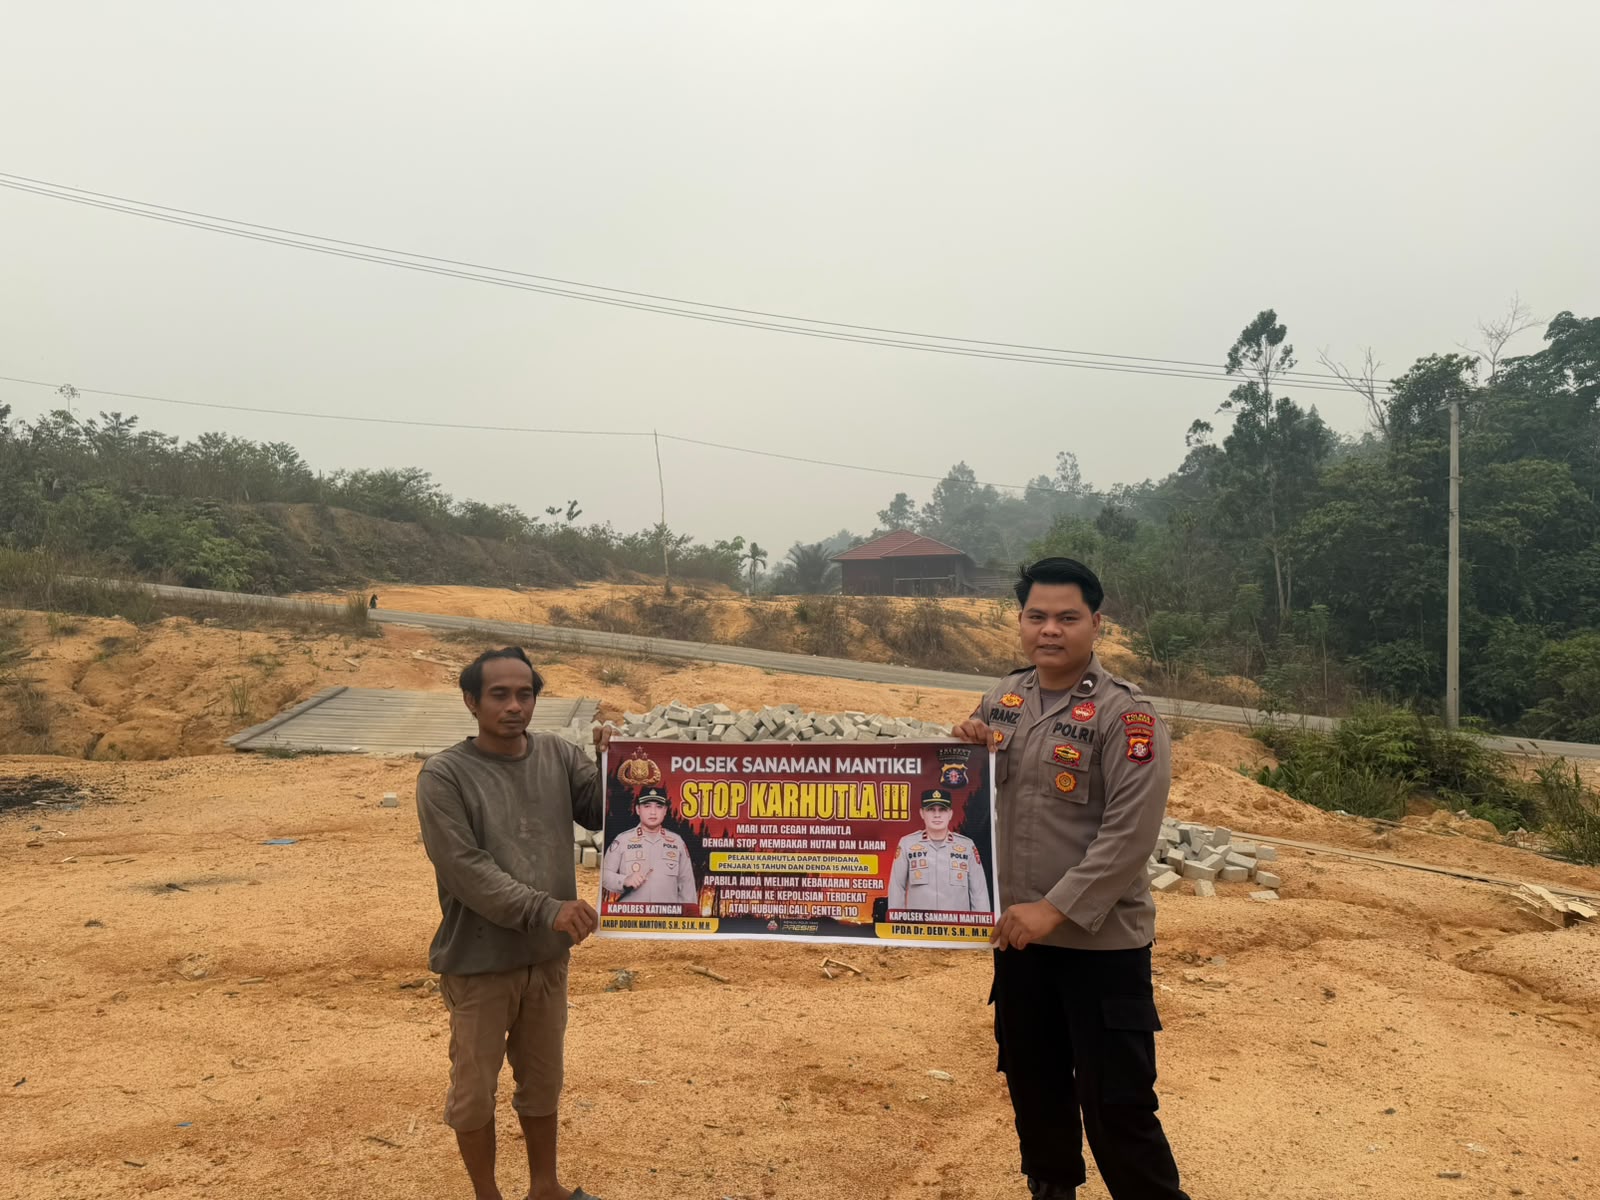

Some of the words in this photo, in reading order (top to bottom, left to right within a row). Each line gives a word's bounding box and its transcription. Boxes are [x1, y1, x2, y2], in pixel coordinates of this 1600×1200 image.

[989, 708, 1021, 724] FRANZ
[1053, 722, 1095, 743] POLRI
[670, 756, 738, 773] POLSEK
[742, 757, 831, 774] SANAMAN
[836, 757, 922, 775] MANTIKEI
[681, 780, 747, 820] STOP
[750, 780, 879, 821] KARHUTLA
[736, 824, 758, 834] MARI
[760, 825, 778, 834] KITA
[780, 825, 807, 835] CEGAH
[809, 825, 851, 836] KARHUTLA
[702, 838, 734, 848] DENGAN
[736, 838, 757, 848] STOP
[759, 838, 808, 849] MEMBAKAR
[810, 839, 837, 850] HUTAN
[839, 840, 857, 850] DAN
[858, 840, 887, 850] LAHAN
[727, 854, 756, 862] PELAKU
[756, 855, 796, 863] KARHUTLA
[797, 855, 821, 863] DAPAT
[908, 851, 927, 859] DEDY
[761, 863, 786, 871] TAHUN
[704, 875, 738, 886] APABILA
[739, 876, 762, 887] ANDA
[763, 877, 800, 888] MELIHAT
[801, 877, 850, 889] KEBAKARAN
[852, 879, 884, 890] SEGERA
[720, 889, 762, 900] LAPORKAN
[764, 890, 775, 900] KE
[777, 891, 824, 902] KEPOLISIAN
[826, 892, 867, 903] TERDEKAT
[607, 904, 645, 914] KAPOLRES
[645, 904, 682, 915] KATINGAN
[728, 903, 749, 914] ATAU
[751, 904, 787, 915] HUBUNGI
[789, 905, 809, 915] CALL
[811, 905, 842, 916] CENTER
[844, 906, 858, 917] 110
[602, 919, 618, 928] AKBP
[619, 920, 638, 929] DODIK
[889, 911, 924, 922] KAPOLSEK
[924, 912, 958, 924] SANAMAN
[959, 913, 993, 925] MANTIKEI
[892, 925, 912, 935] IPDA
[913, 926, 925, 936] Dr.
